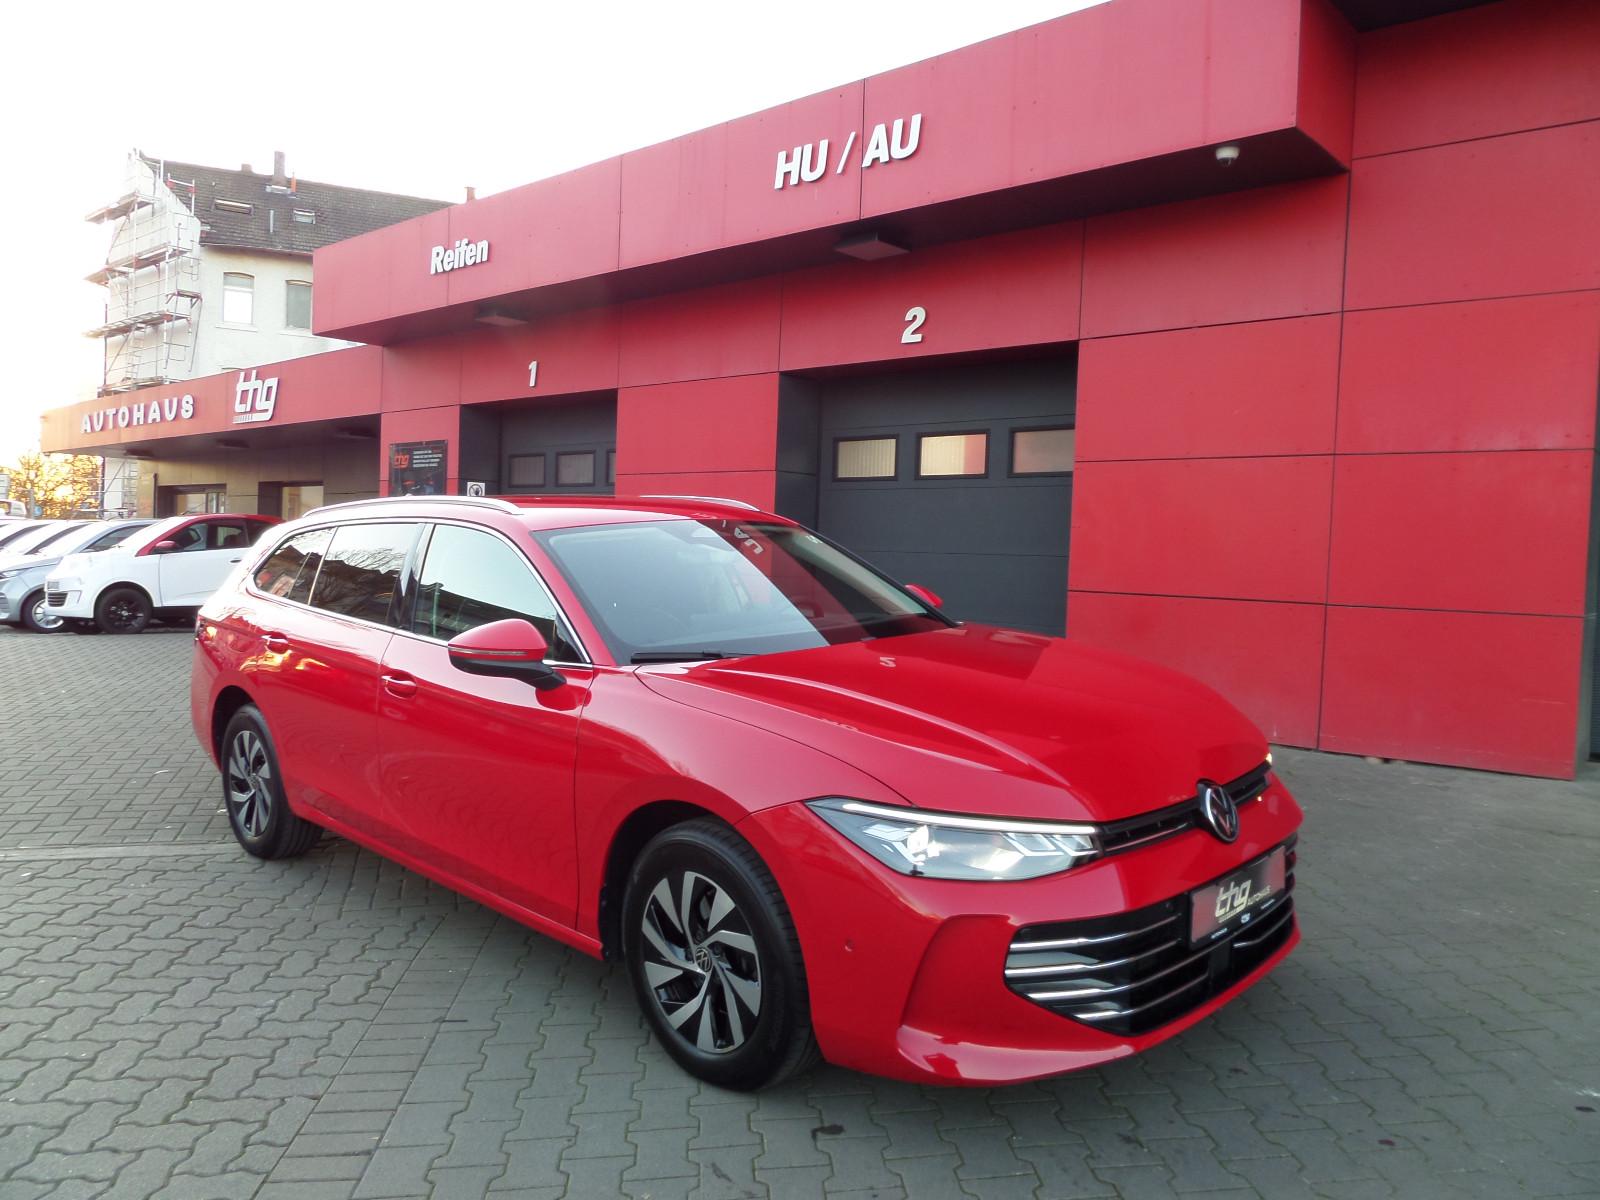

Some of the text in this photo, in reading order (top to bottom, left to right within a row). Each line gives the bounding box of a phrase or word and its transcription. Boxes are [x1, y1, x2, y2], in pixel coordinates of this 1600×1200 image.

[774, 113, 922, 190] HU / AU
[430, 238, 489, 275] Reifen
[901, 306, 926, 343] 2
[528, 360, 538, 387] 1
[80, 394, 195, 434] AUTOHAUS
[233, 370, 278, 424] thg
[1215, 879, 1252, 923] thg
